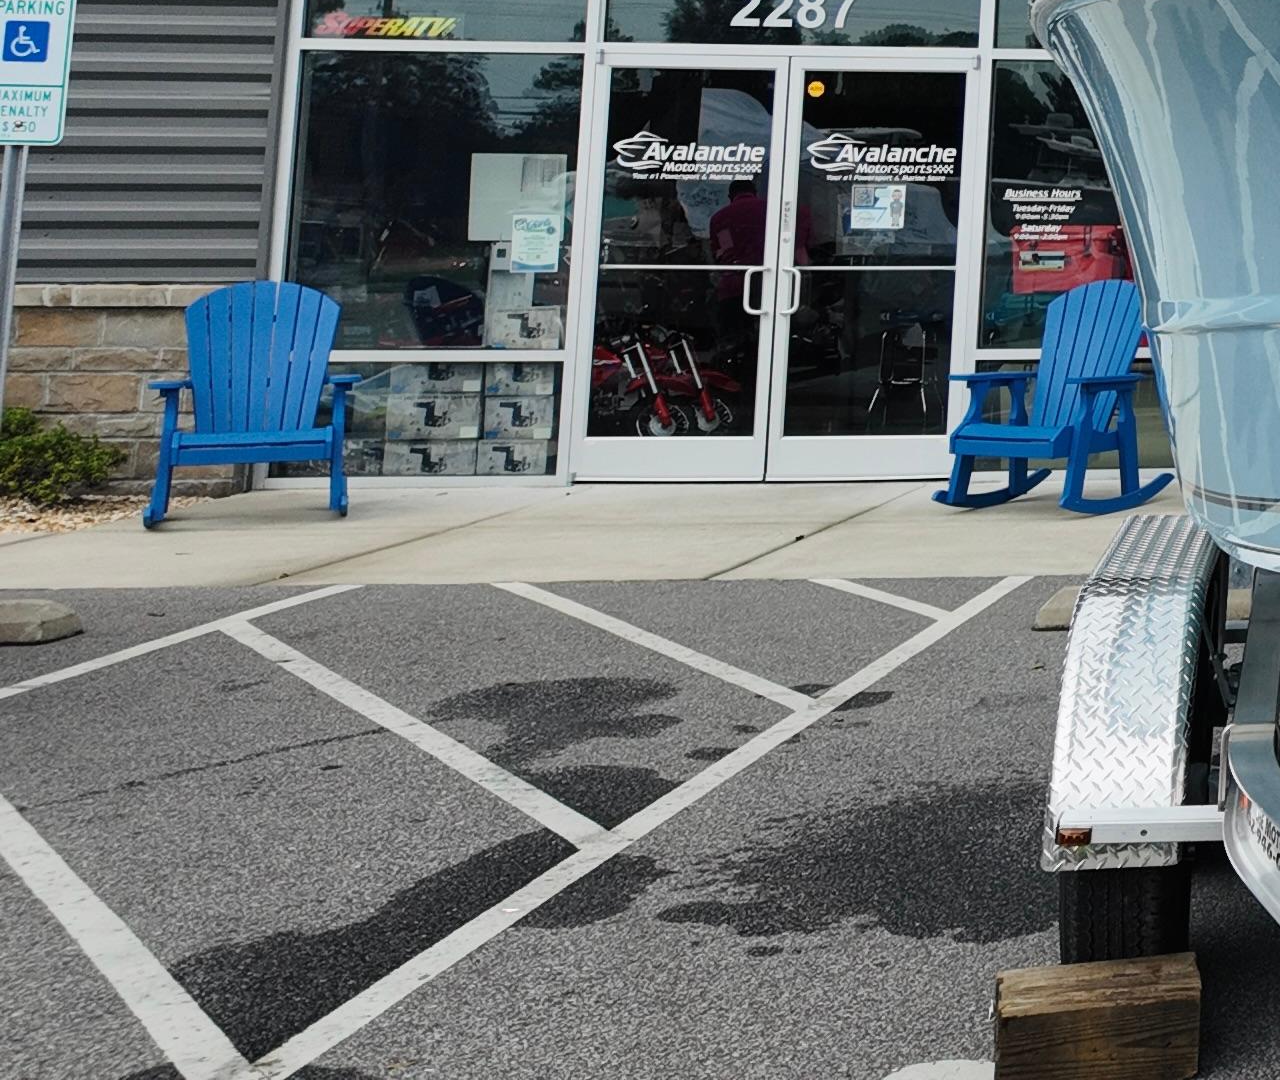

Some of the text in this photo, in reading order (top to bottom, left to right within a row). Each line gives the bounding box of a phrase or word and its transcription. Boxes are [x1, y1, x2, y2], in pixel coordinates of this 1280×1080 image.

[0, 90, 52, 102] AXIMUM
[0, 105, 49, 118] ENALTY
[642, 142, 766, 163] Avalanche
[835, 143, 958, 164] Avalanche
[663, 161, 741, 174] Motorsports
[855, 163, 934, 176] Motorsports
[1004, 188, 1082, 198] Business Hours
[1020, 223, 1063, 233] Saturday
